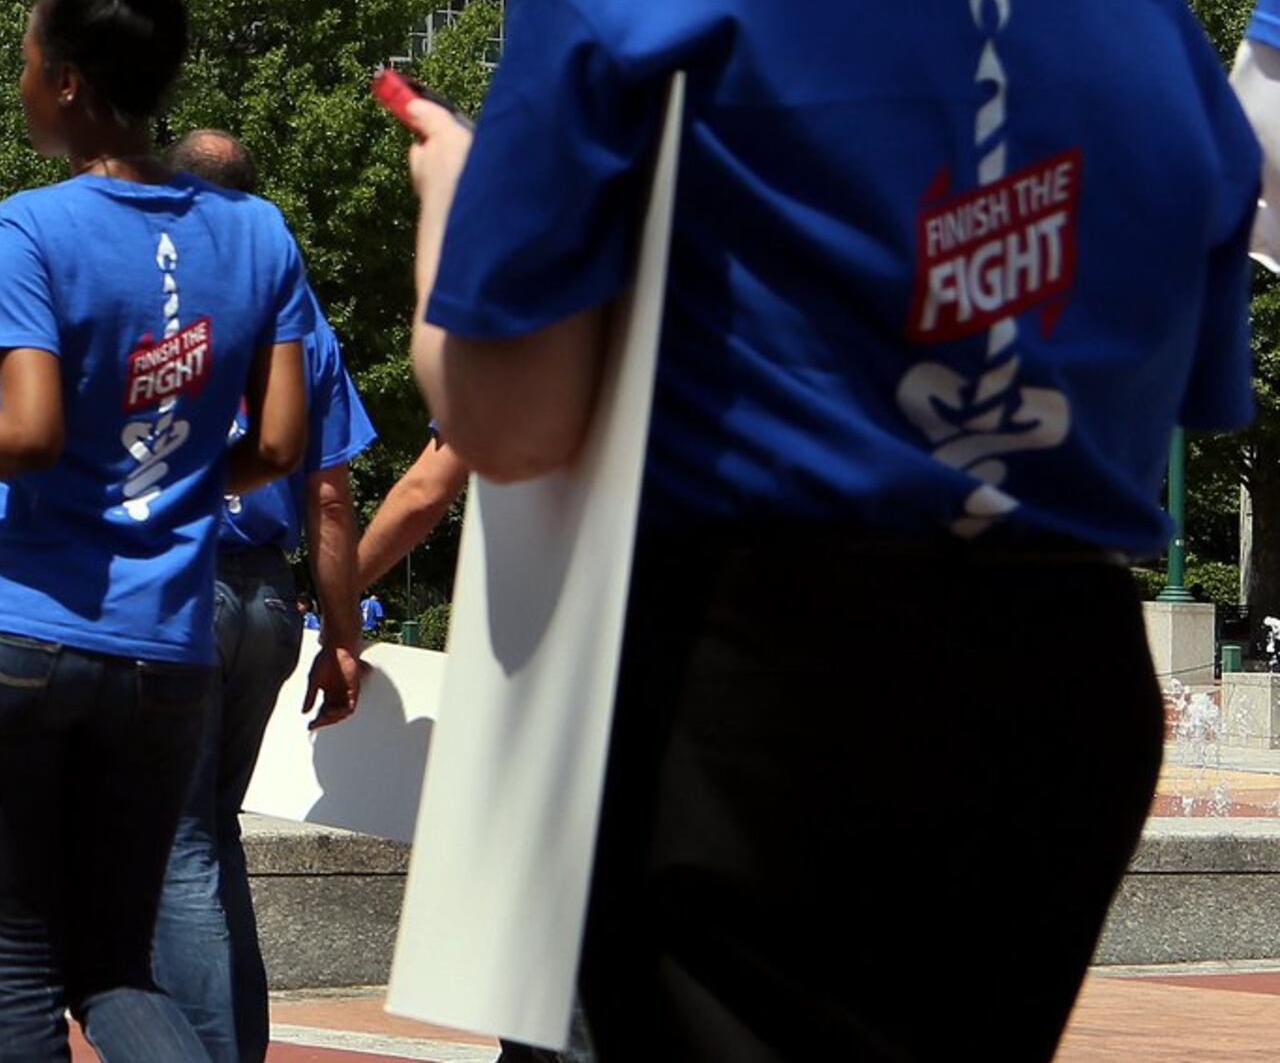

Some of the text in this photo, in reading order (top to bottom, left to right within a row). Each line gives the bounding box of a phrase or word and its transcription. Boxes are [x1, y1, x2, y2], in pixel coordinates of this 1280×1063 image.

[925, 161, 1074, 258] FINISH THE
[918, 210, 1068, 331] FIGHT
[129, 343, 209, 405] FIGHT
[133, 321, 209, 374] FINISH THE
